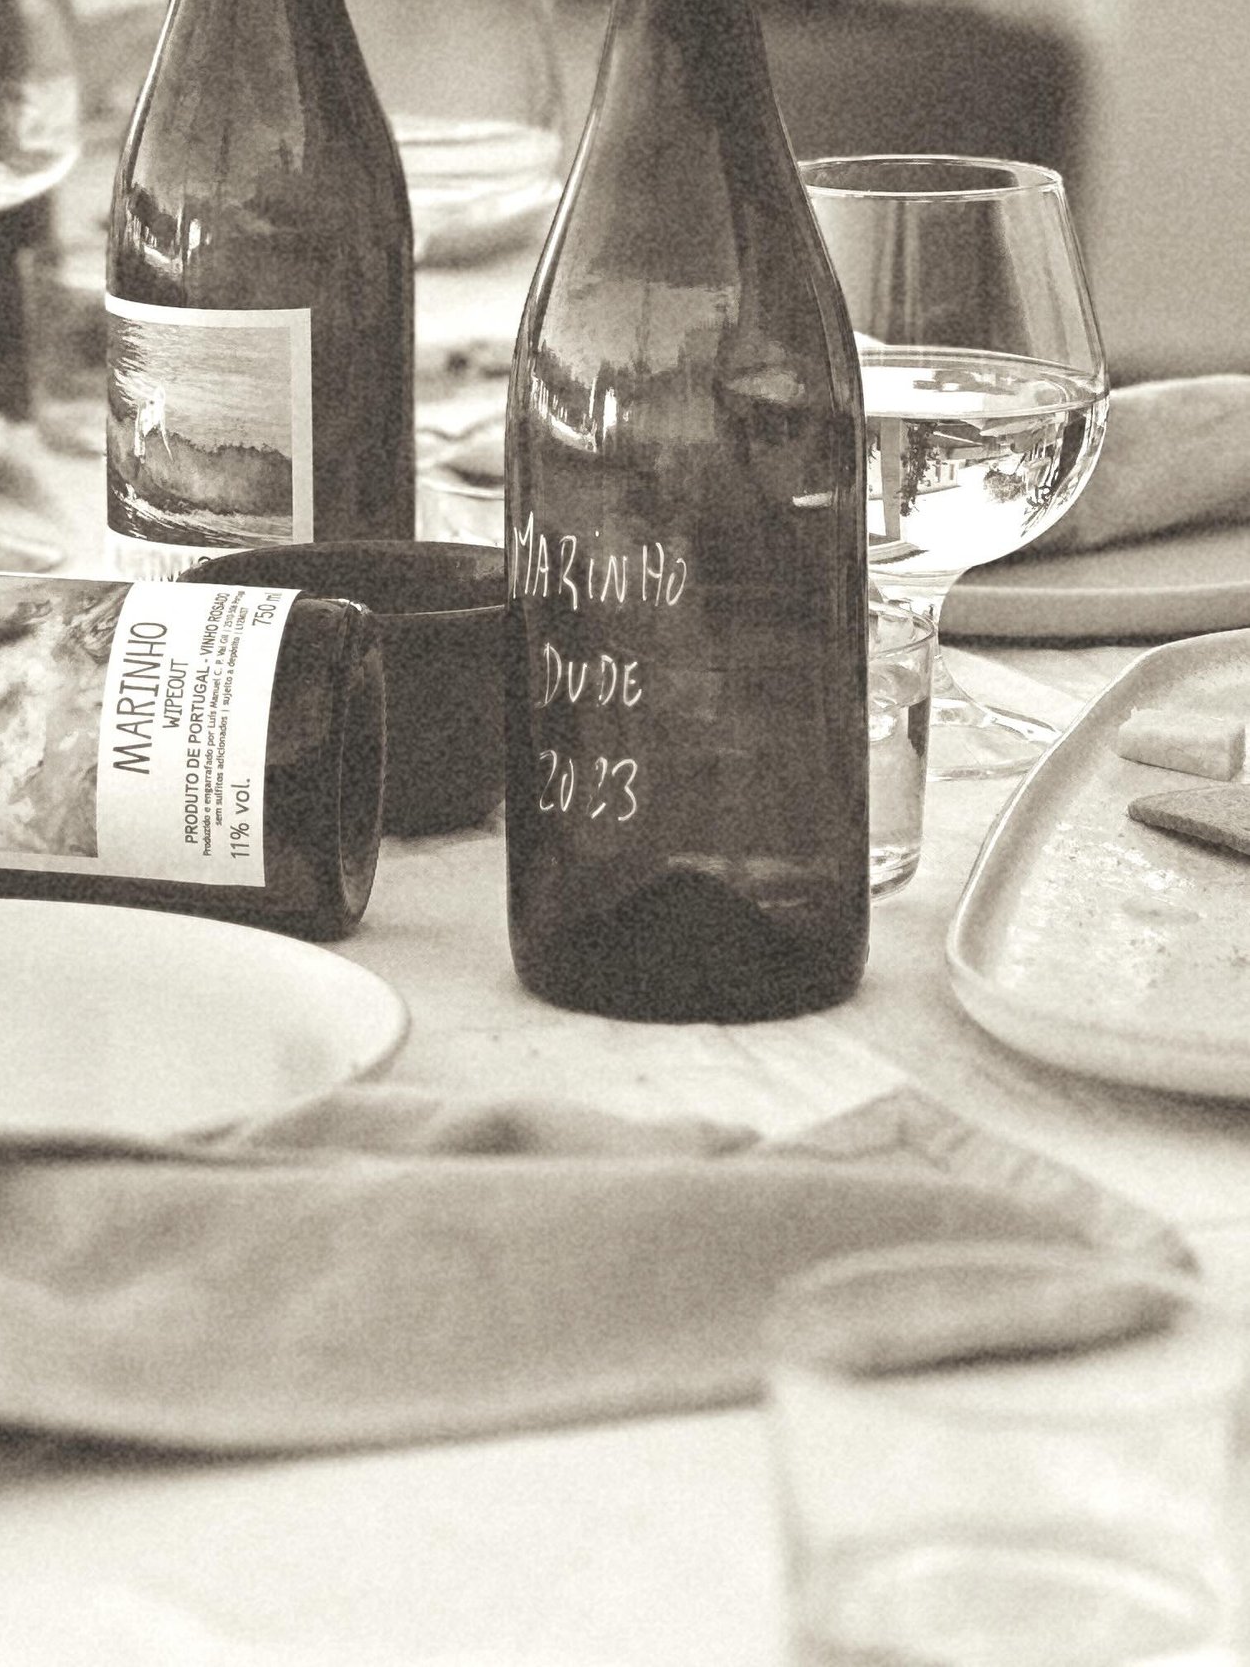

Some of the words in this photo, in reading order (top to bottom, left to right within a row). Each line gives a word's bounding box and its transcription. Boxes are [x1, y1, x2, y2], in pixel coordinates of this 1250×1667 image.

[208, 593, 230, 622] ROSADO
[252, 604, 276, 626] 750
[265, 592, 282, 602] ml
[199, 624, 219, 656] VINHO
[213, 667, 223, 676] C.
[538, 642, 642, 708] DUDE
[112, 621, 168, 775] MARINHO
[162, 659, 189, 729] WIPEOUT
[188, 666, 210, 744] PORTUGAL
[209, 678, 221, 709] Manuel
[223, 676, 233, 706] sujeito
[207, 731, 216, 747] por
[216, 716, 228, 770] adicionados
[187, 748, 201, 768] DE
[204, 749, 214, 804] engarrafado
[214, 772, 224, 805] sulfitos
[230, 778, 251, 815] vol.
[185, 773, 199, 844] PRODUTO
[202, 815, 212, 856] Produzido
[230, 822, 250, 859] 11%
